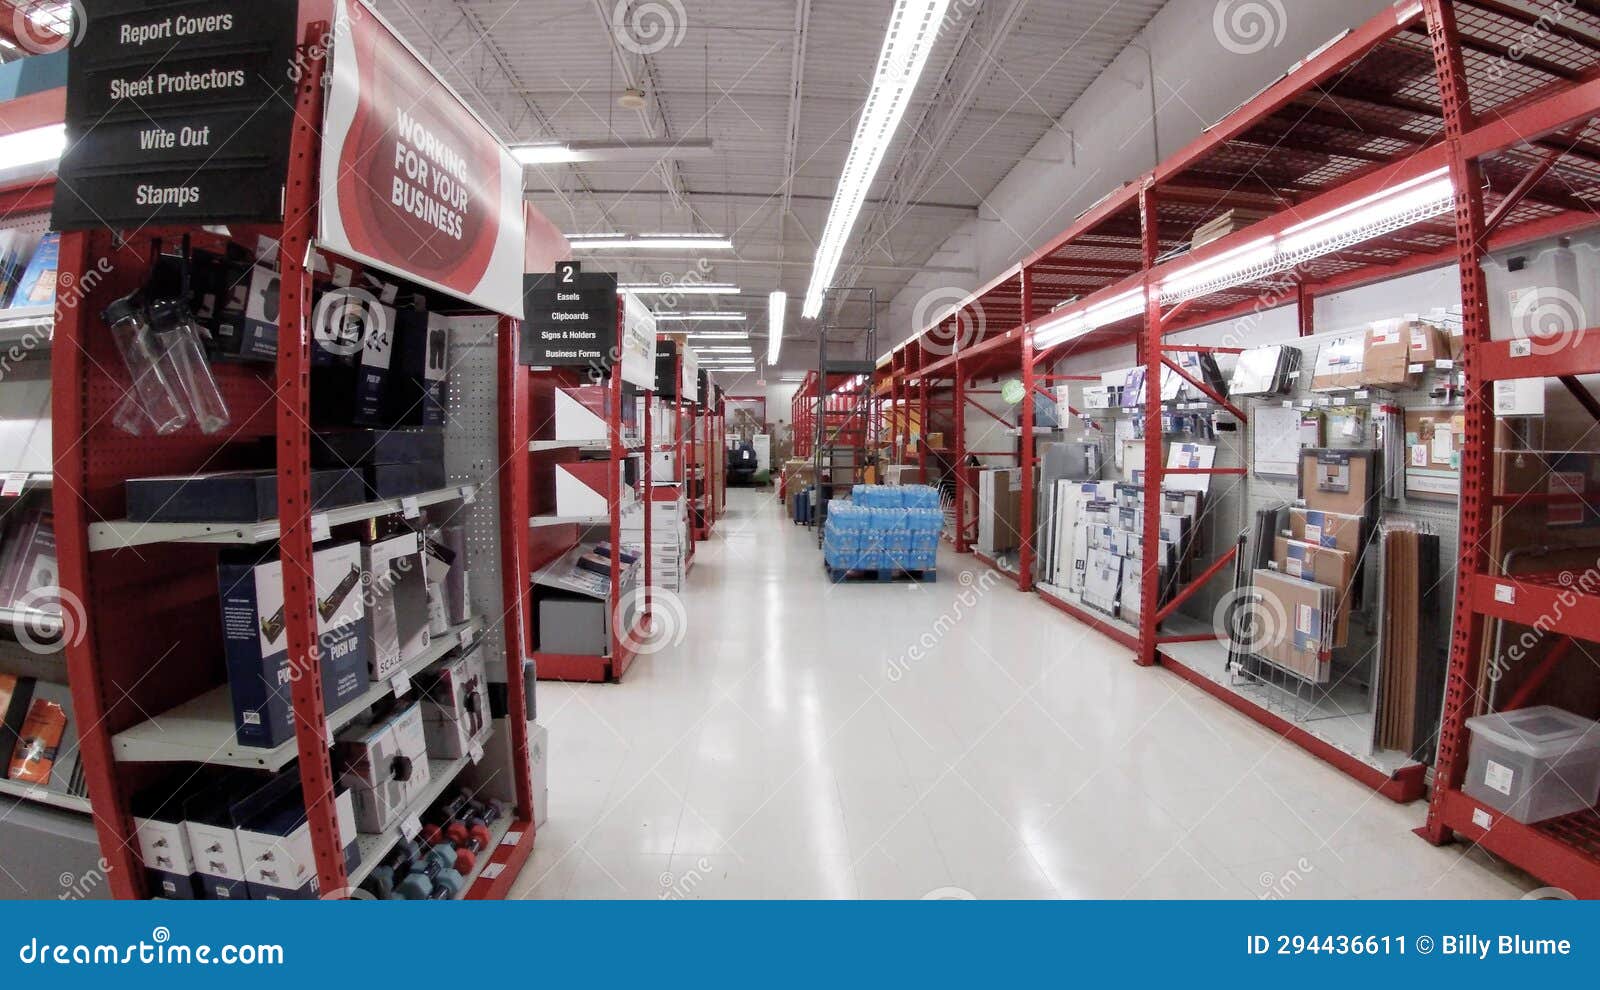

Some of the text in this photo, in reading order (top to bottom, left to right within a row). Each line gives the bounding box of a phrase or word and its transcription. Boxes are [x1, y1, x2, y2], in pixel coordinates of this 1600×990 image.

[120, 13, 233, 45] Report Covers
[110, 69, 244, 100] Sheet Protectors
[140, 125, 210, 150] Wite Out
[396, 108, 468, 184] WORKING
[394, 141, 468, 214] FOR YOUR
[136, 183, 200, 208] Stamps
[391, 175, 462, 240] BUSINESS
[562, 266, 574, 283] 2
[557, 292, 580, 301] Easels
[551, 312, 589, 321] Clipboards
[541, 331, 596, 340] Signs & Holders
[545, 350, 600, 358] Business Forms
